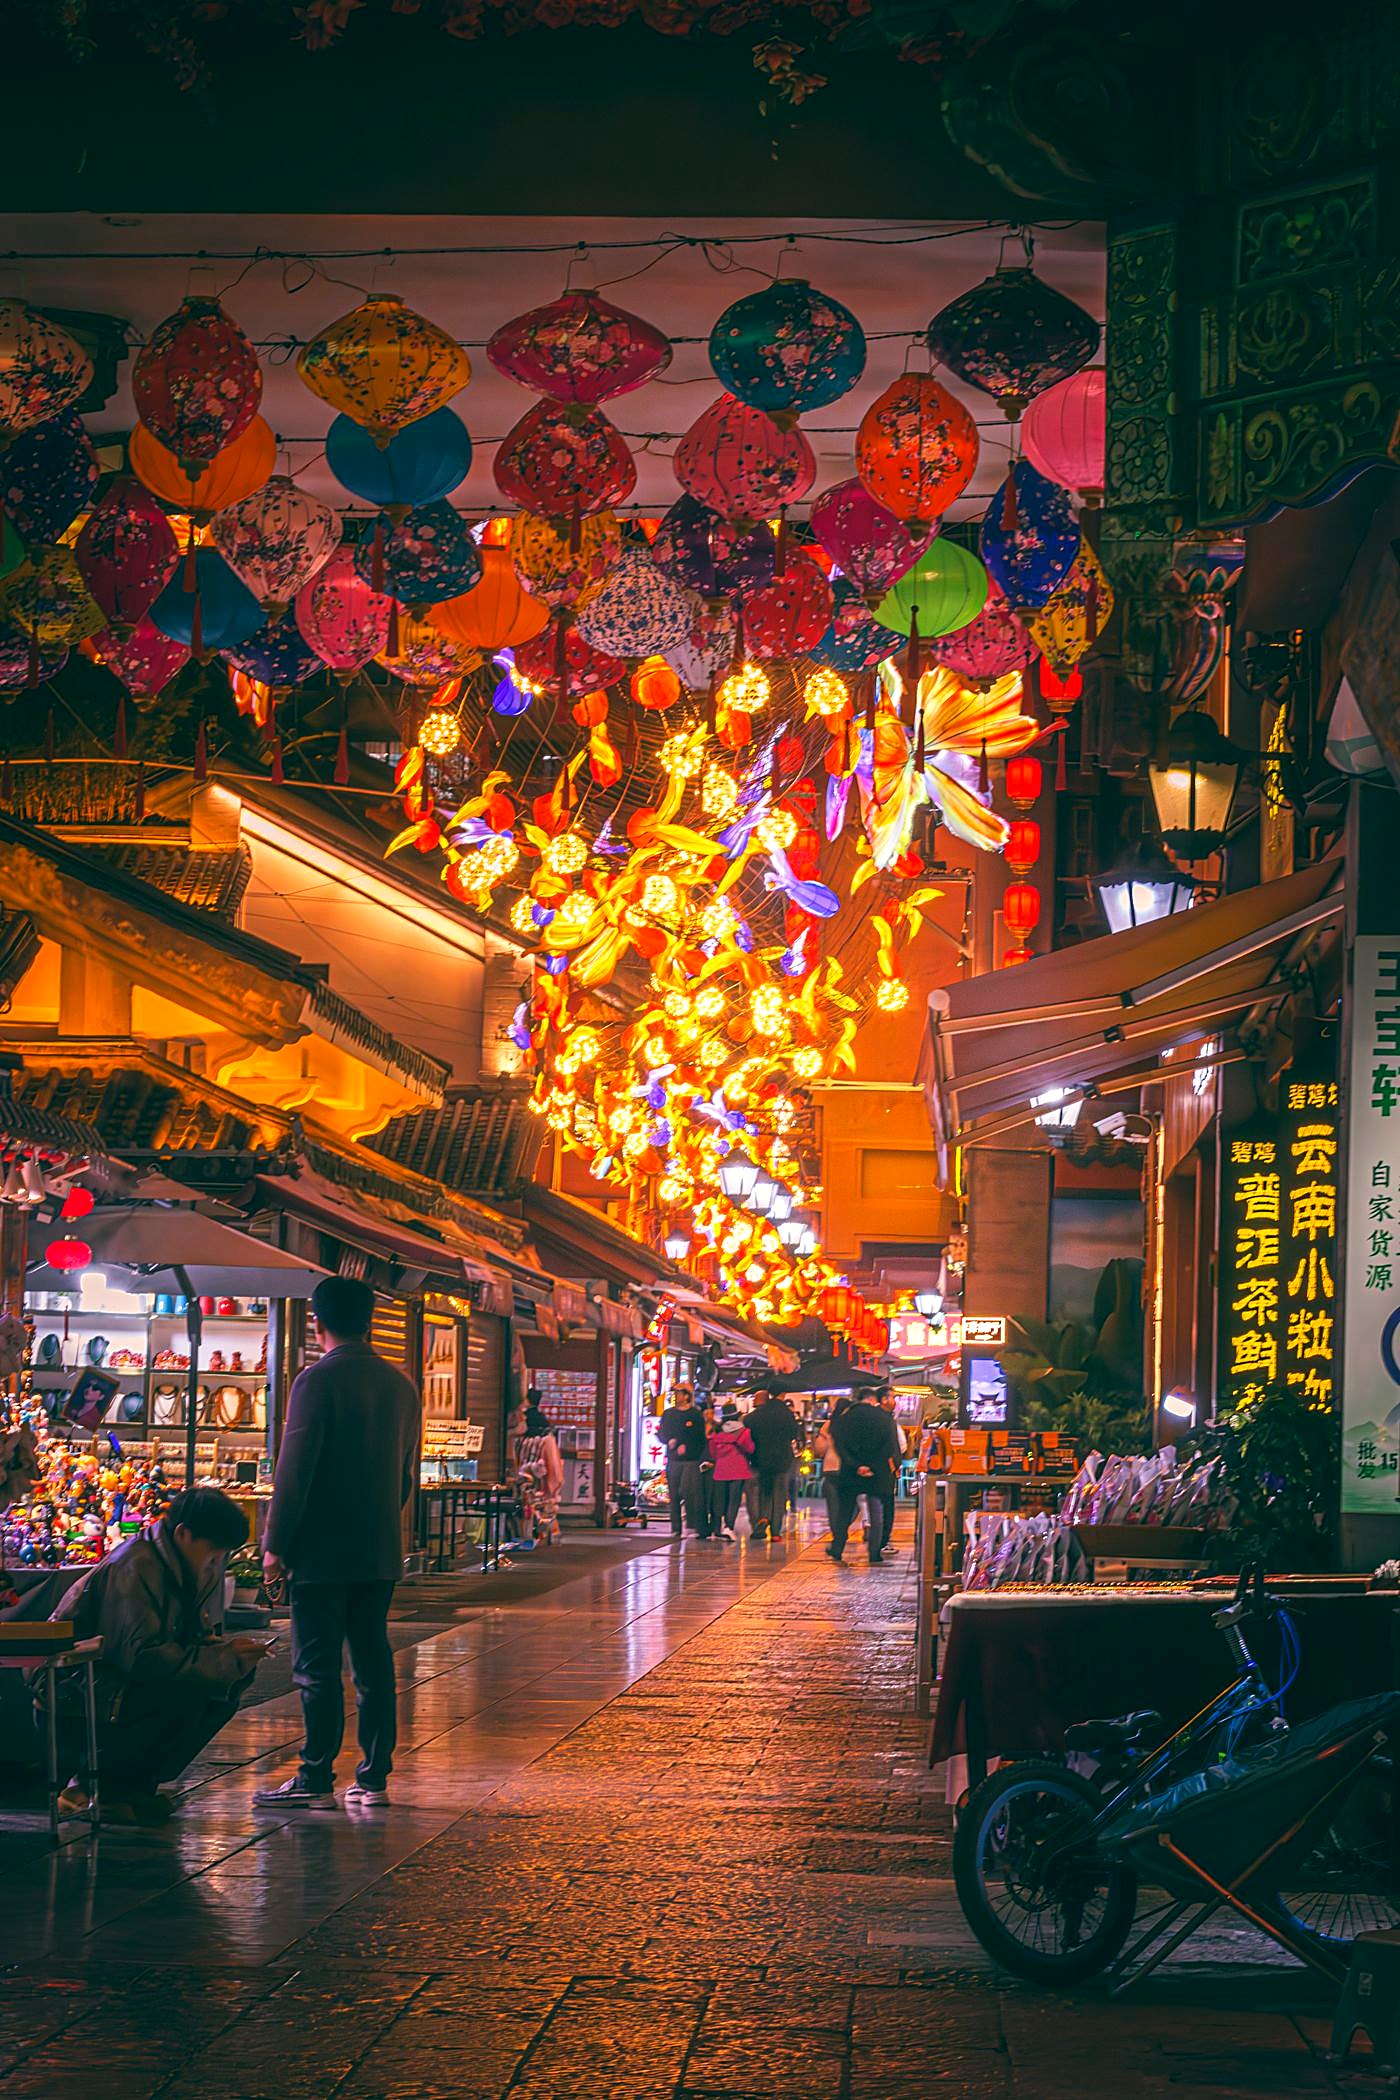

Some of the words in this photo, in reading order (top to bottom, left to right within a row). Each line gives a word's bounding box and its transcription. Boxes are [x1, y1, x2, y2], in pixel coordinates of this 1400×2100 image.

[1365, 1160, 1394, 1291] 自家货源
[1357, 1440, 1377, 1480] 批发
